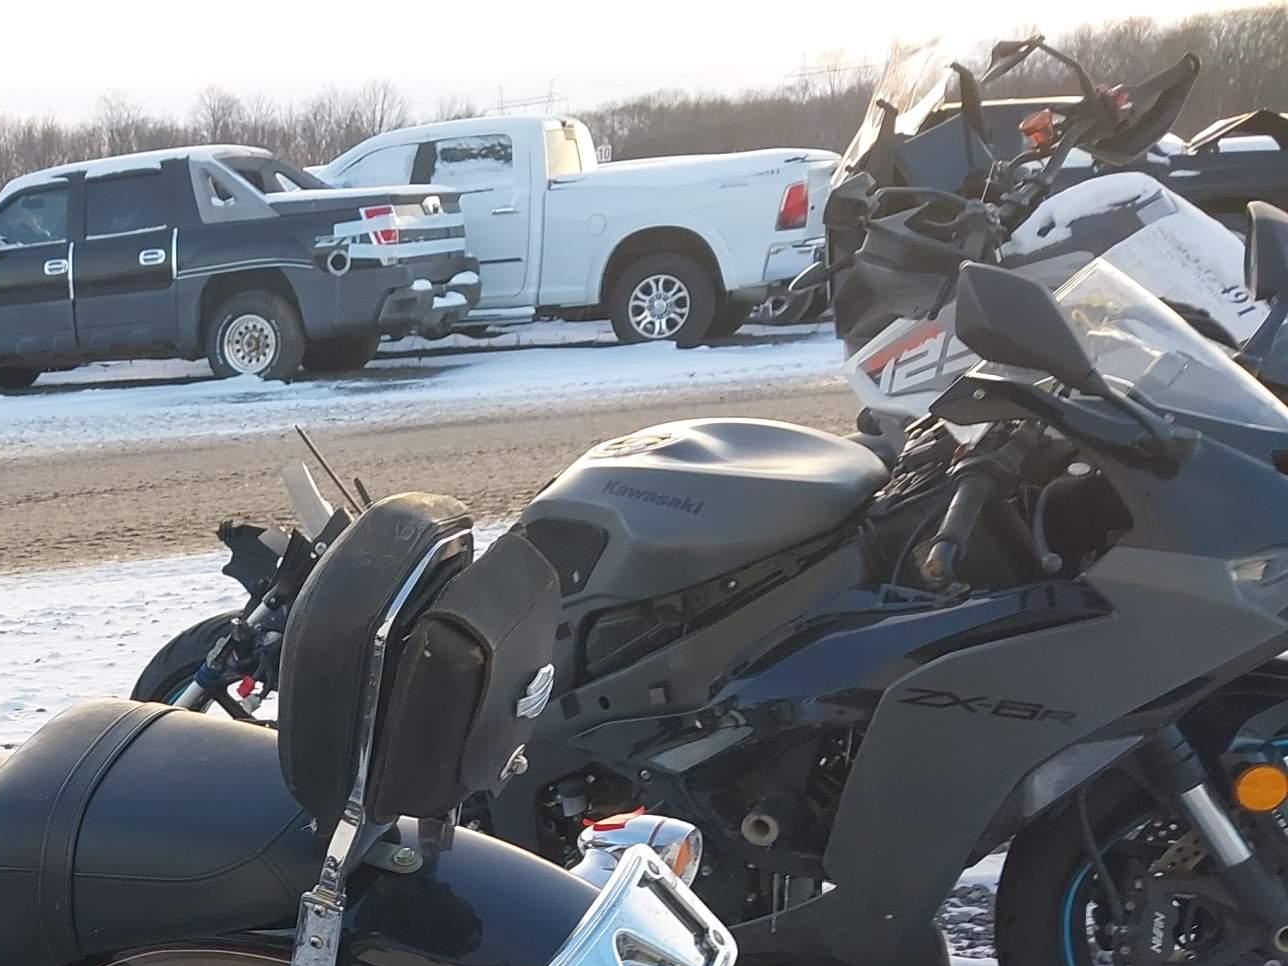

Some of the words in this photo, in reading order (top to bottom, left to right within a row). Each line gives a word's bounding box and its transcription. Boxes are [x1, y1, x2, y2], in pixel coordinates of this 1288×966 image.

[598, 147, 610, 161] 10
[601, 479, 704, 516] Kawasaki
[896, 687, 1077, 727] ZX-6R
